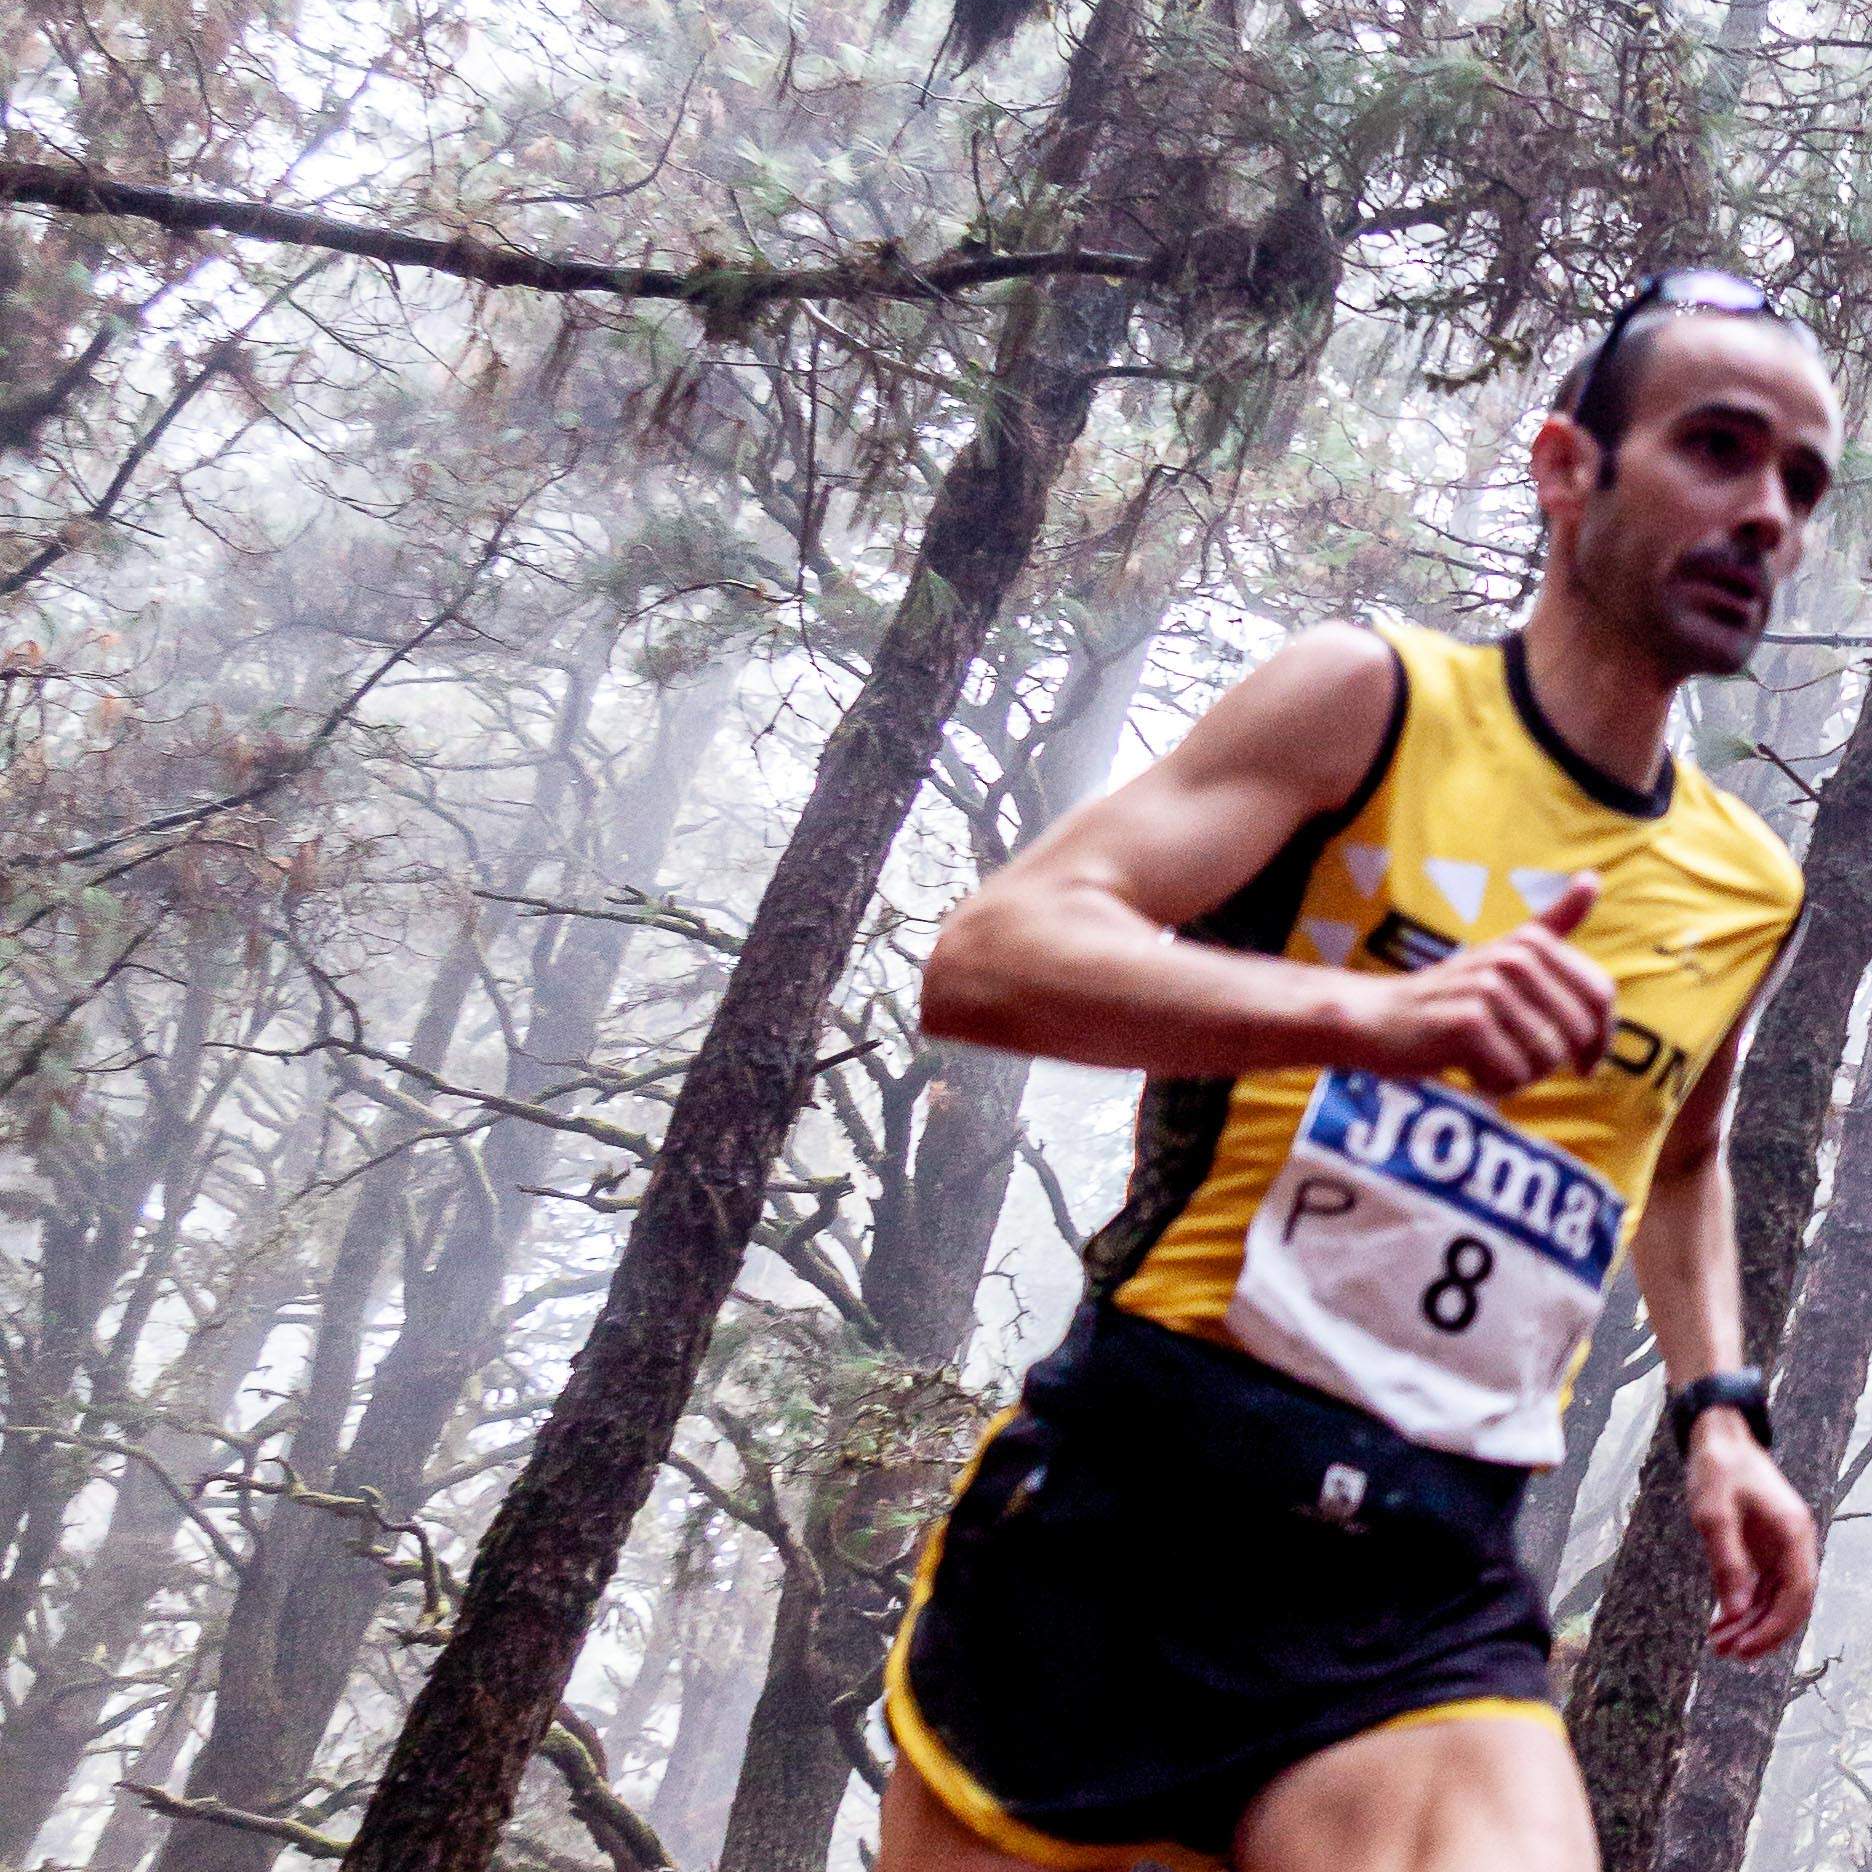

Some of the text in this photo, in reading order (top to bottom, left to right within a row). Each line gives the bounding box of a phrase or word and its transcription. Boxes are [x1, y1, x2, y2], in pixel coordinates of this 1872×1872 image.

[1282, 1178, 1357, 1245] P
[1347, 1081, 1594, 1259] Joma
[1422, 1234, 1493, 1332] 8
